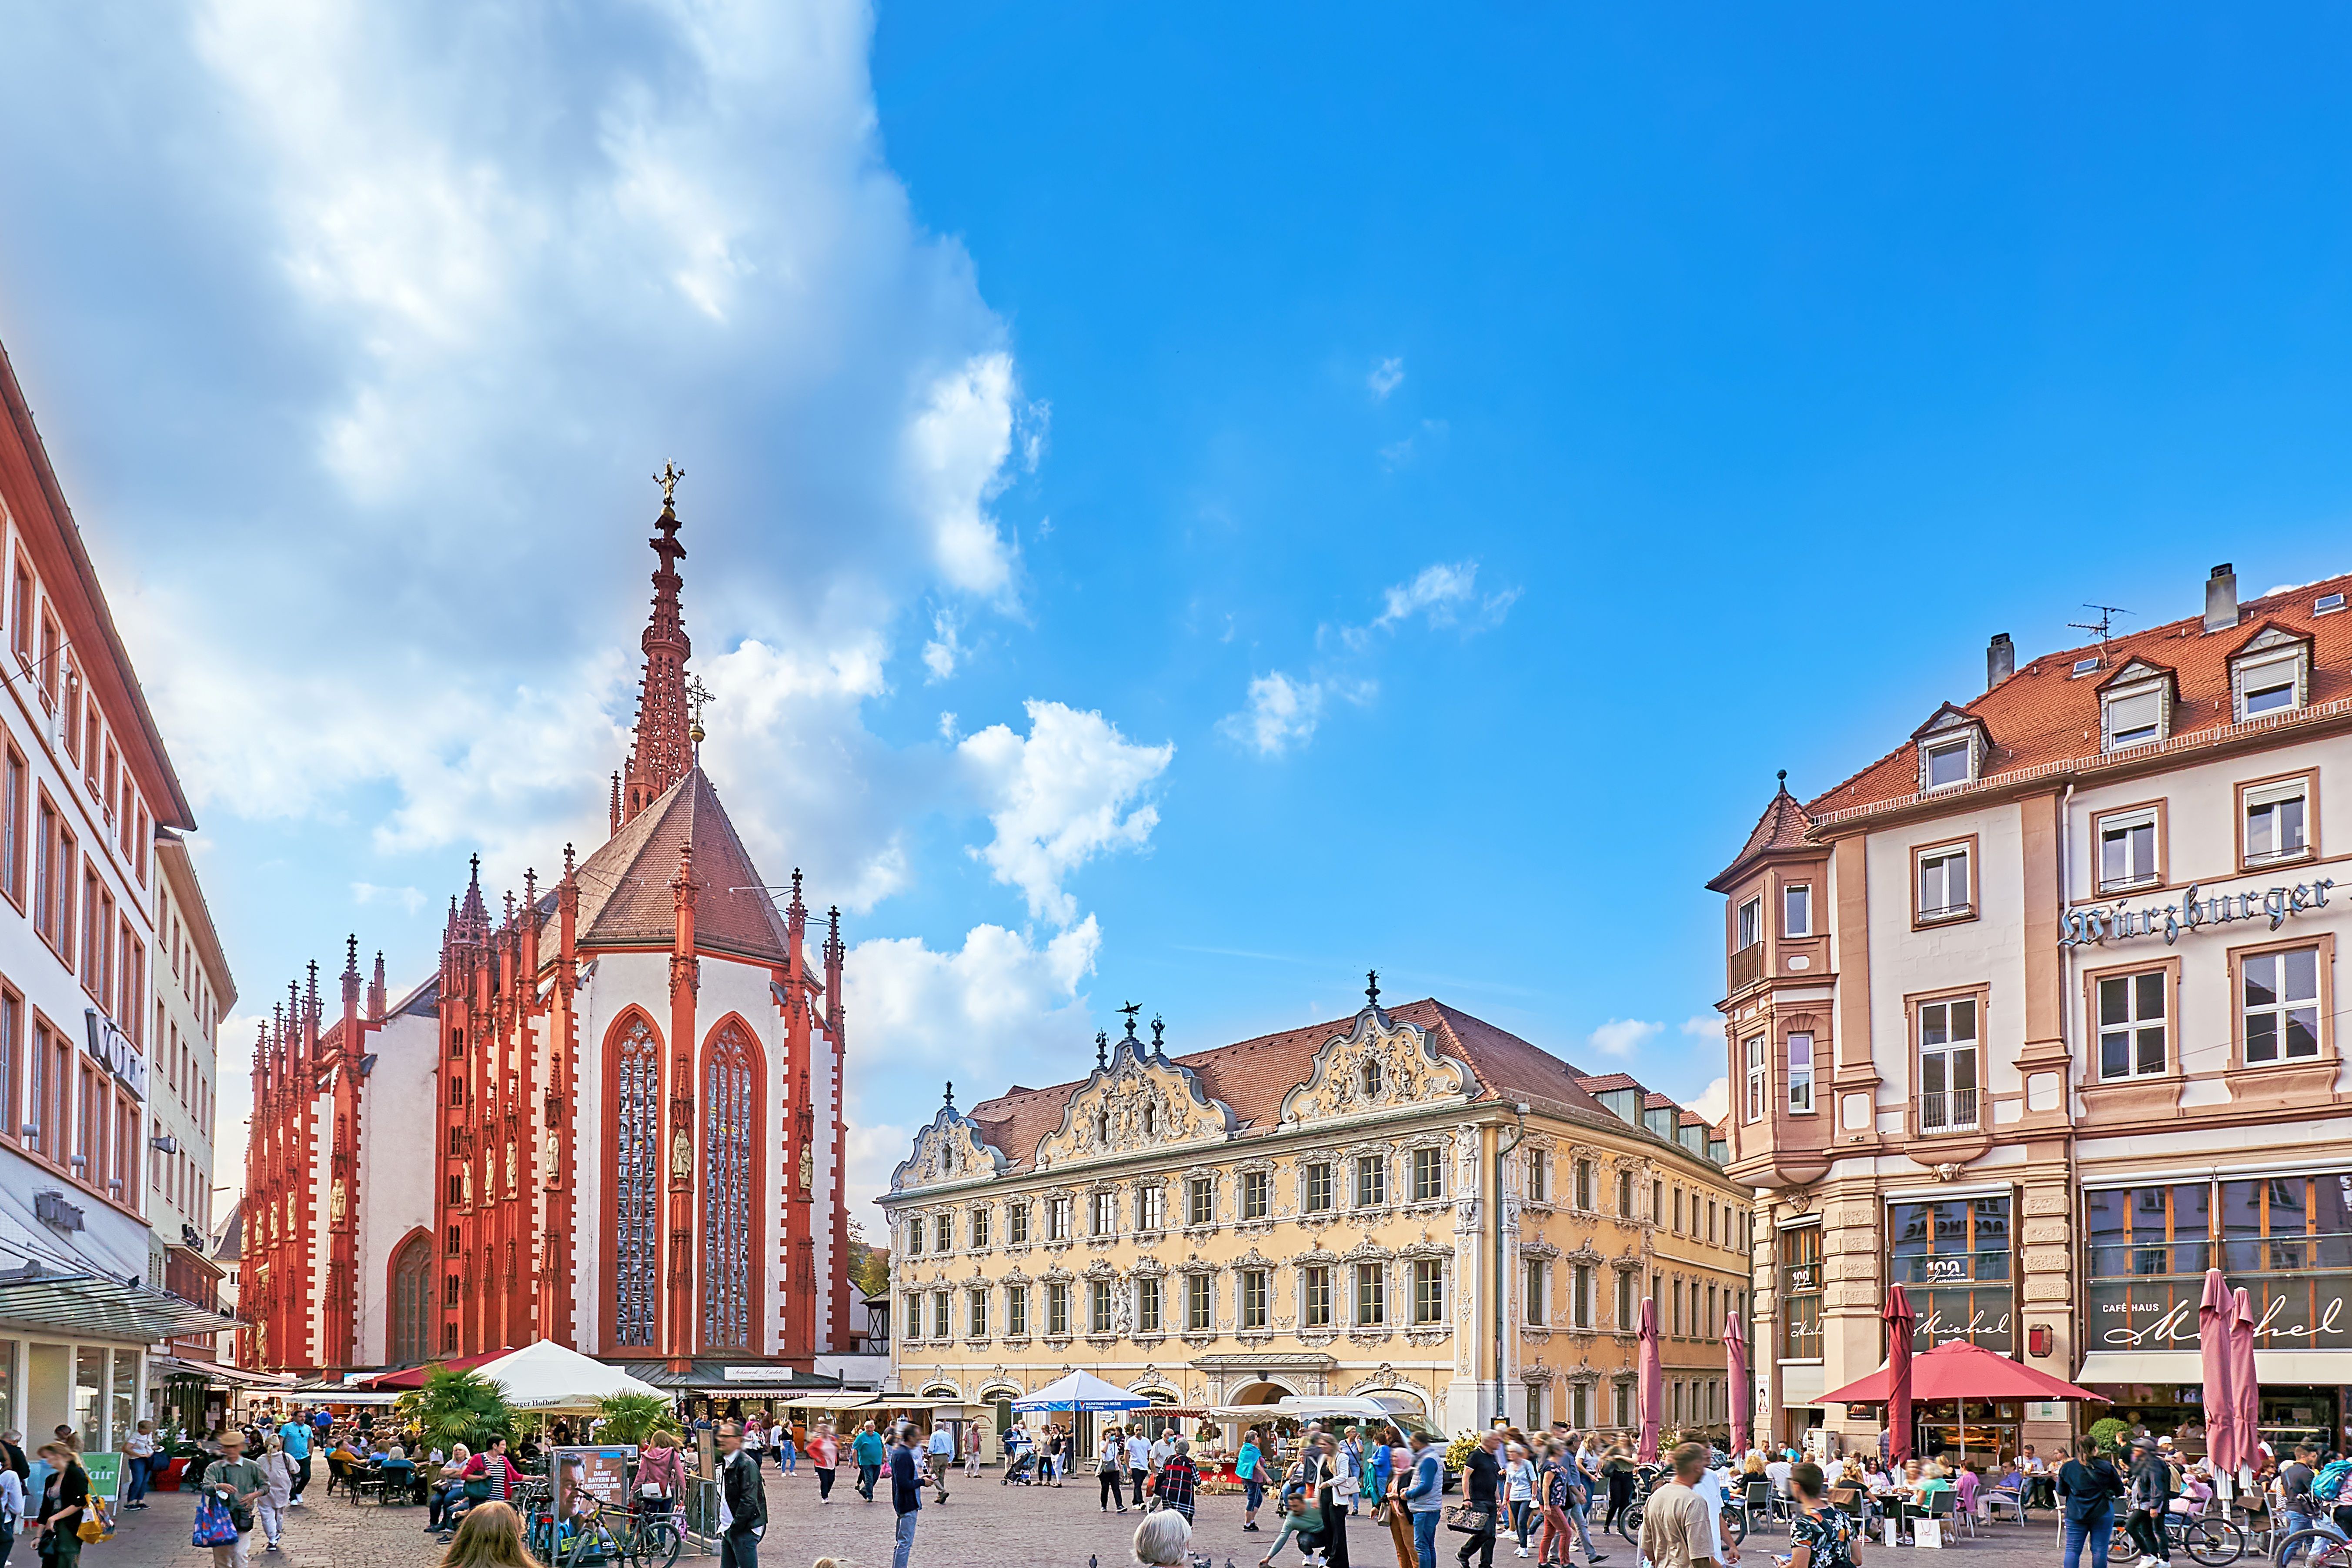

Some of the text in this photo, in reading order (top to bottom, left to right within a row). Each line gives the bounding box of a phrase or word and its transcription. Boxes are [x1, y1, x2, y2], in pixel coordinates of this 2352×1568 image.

[2058, 876, 2335, 946] Würzburger
[1926, 1260, 1960, 1273] 100
[1792, 1270, 1810, 1281] 100
[1927, 1268, 1966, 1284] Jahre
[2102, 1302, 2159, 1313] CAFÉ HAUS
[1913, 1310, 2009, 1337] Michel
[2103, 1294, 2344, 1345] Mhel
[1791, 1319, 1824, 1338] Mich
